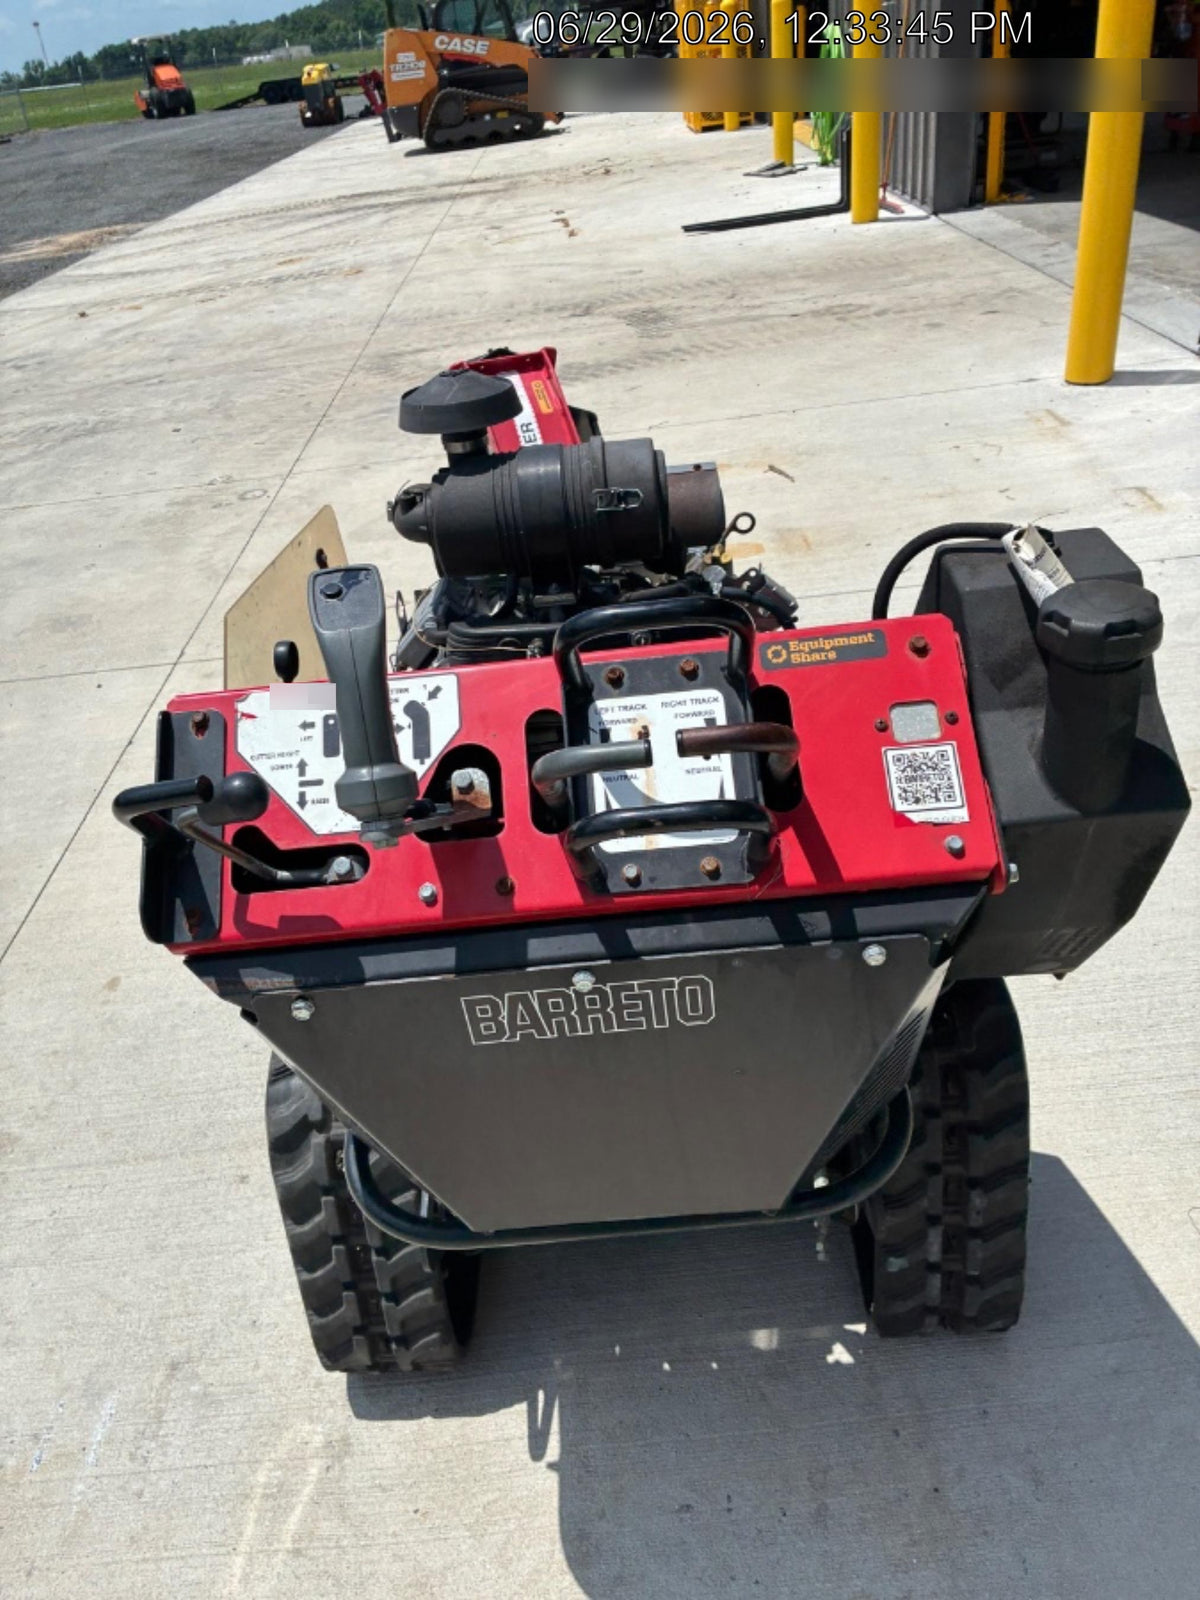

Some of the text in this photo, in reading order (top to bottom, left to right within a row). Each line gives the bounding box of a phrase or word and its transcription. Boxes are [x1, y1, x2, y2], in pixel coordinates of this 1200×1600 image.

[434, 35, 490, 55] CASE
[789, 632, 875, 652] Equipment
[790, 649, 837, 664] Share
[618, 703, 648, 713] TRACK
[661, 696, 720, 709] RIGHT TRACK
[674, 709, 716, 719] FORWARD
[602, 773, 639, 784] NEUTRAL
[461, 975, 716, 1046] BARRETO
